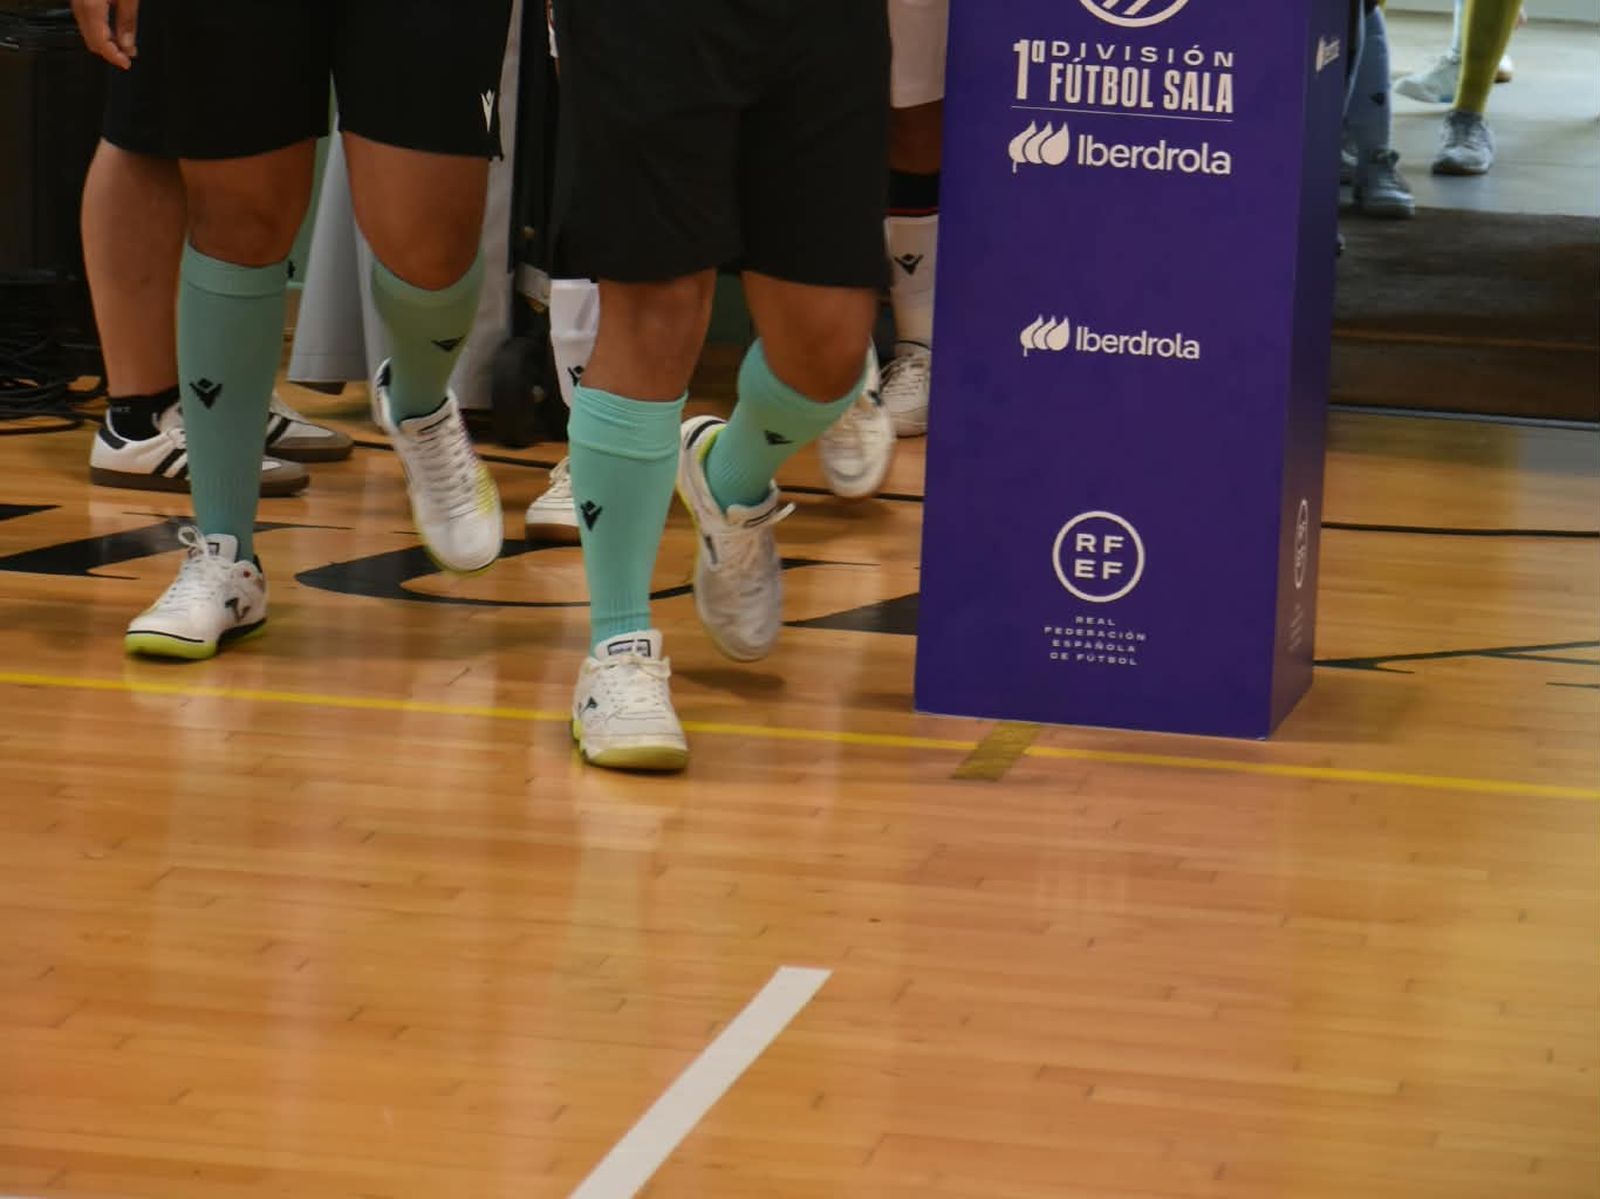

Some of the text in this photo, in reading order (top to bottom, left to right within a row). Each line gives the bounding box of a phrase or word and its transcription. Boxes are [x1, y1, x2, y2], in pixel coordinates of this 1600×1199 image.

[1051, 40, 1234, 68] DIVISIÓN
[1049, 57, 1234, 114] FÚTBOL SALA
[1077, 134, 1232, 175] Iberdrola
[1075, 326, 1200, 360] Iberdrola
[1075, 615, 1116, 626] REAL
[1049, 652, 1069, 660] DE
